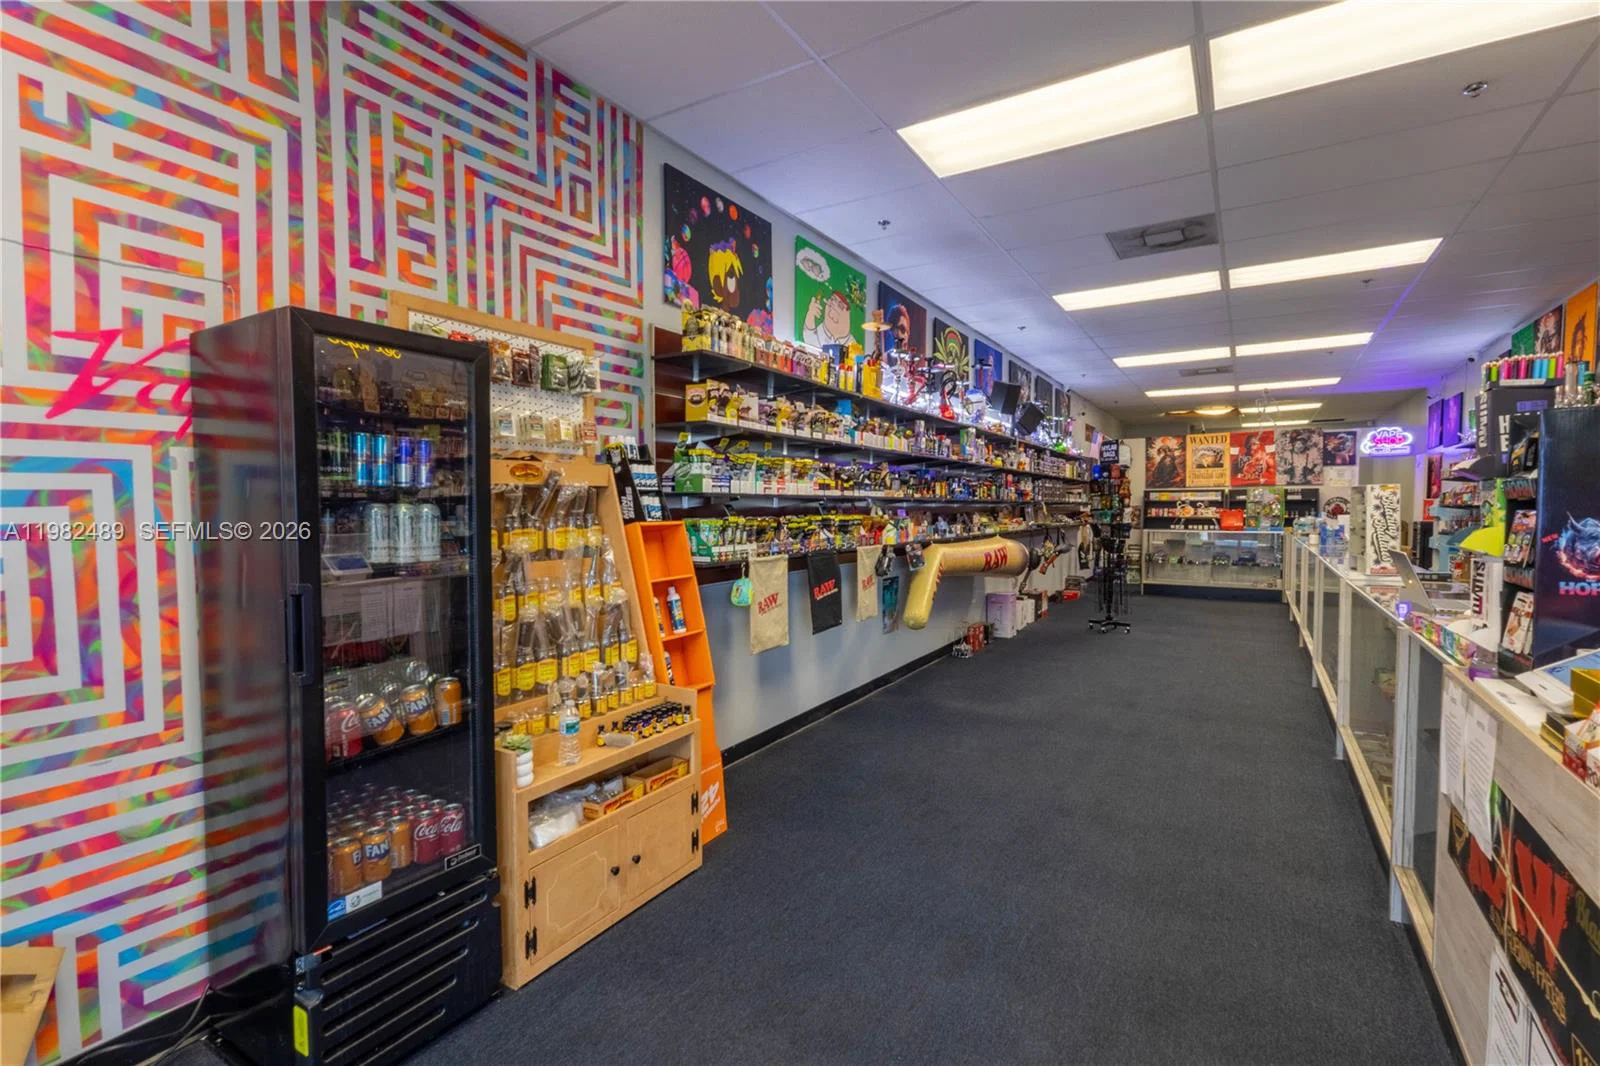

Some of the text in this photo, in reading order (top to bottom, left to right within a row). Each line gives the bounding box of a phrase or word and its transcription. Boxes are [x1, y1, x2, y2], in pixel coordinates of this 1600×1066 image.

[1189, 435, 1227, 445] WANTED
[983, 545, 1009, 571] RAW
[812, 579, 837, 598] RAW
[757, 592, 779, 613] RAW
